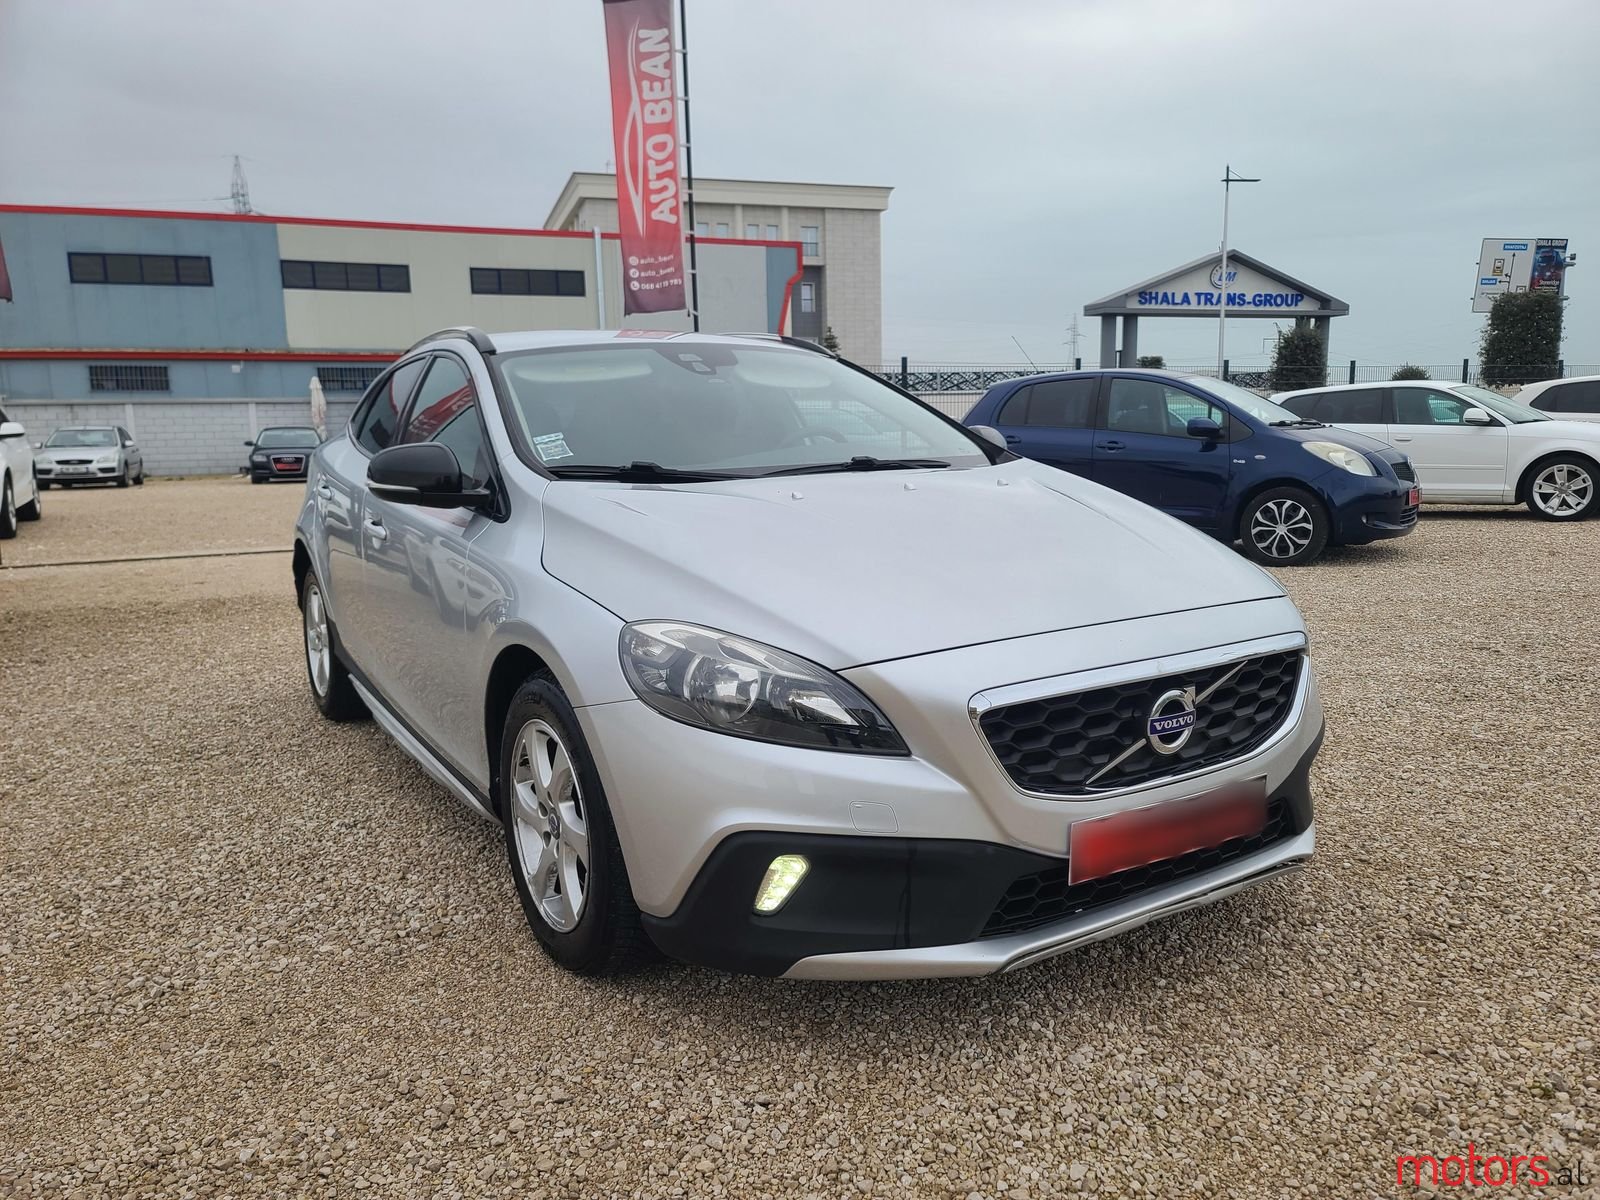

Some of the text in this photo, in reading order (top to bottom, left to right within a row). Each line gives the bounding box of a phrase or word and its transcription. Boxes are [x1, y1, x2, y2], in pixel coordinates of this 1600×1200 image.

[638, 28, 678, 225] AUTO BEAN
[1138, 291, 1304, 308] SHALA TRANS-GROUP
[1153, 715, 1194, 731] VOLVO
